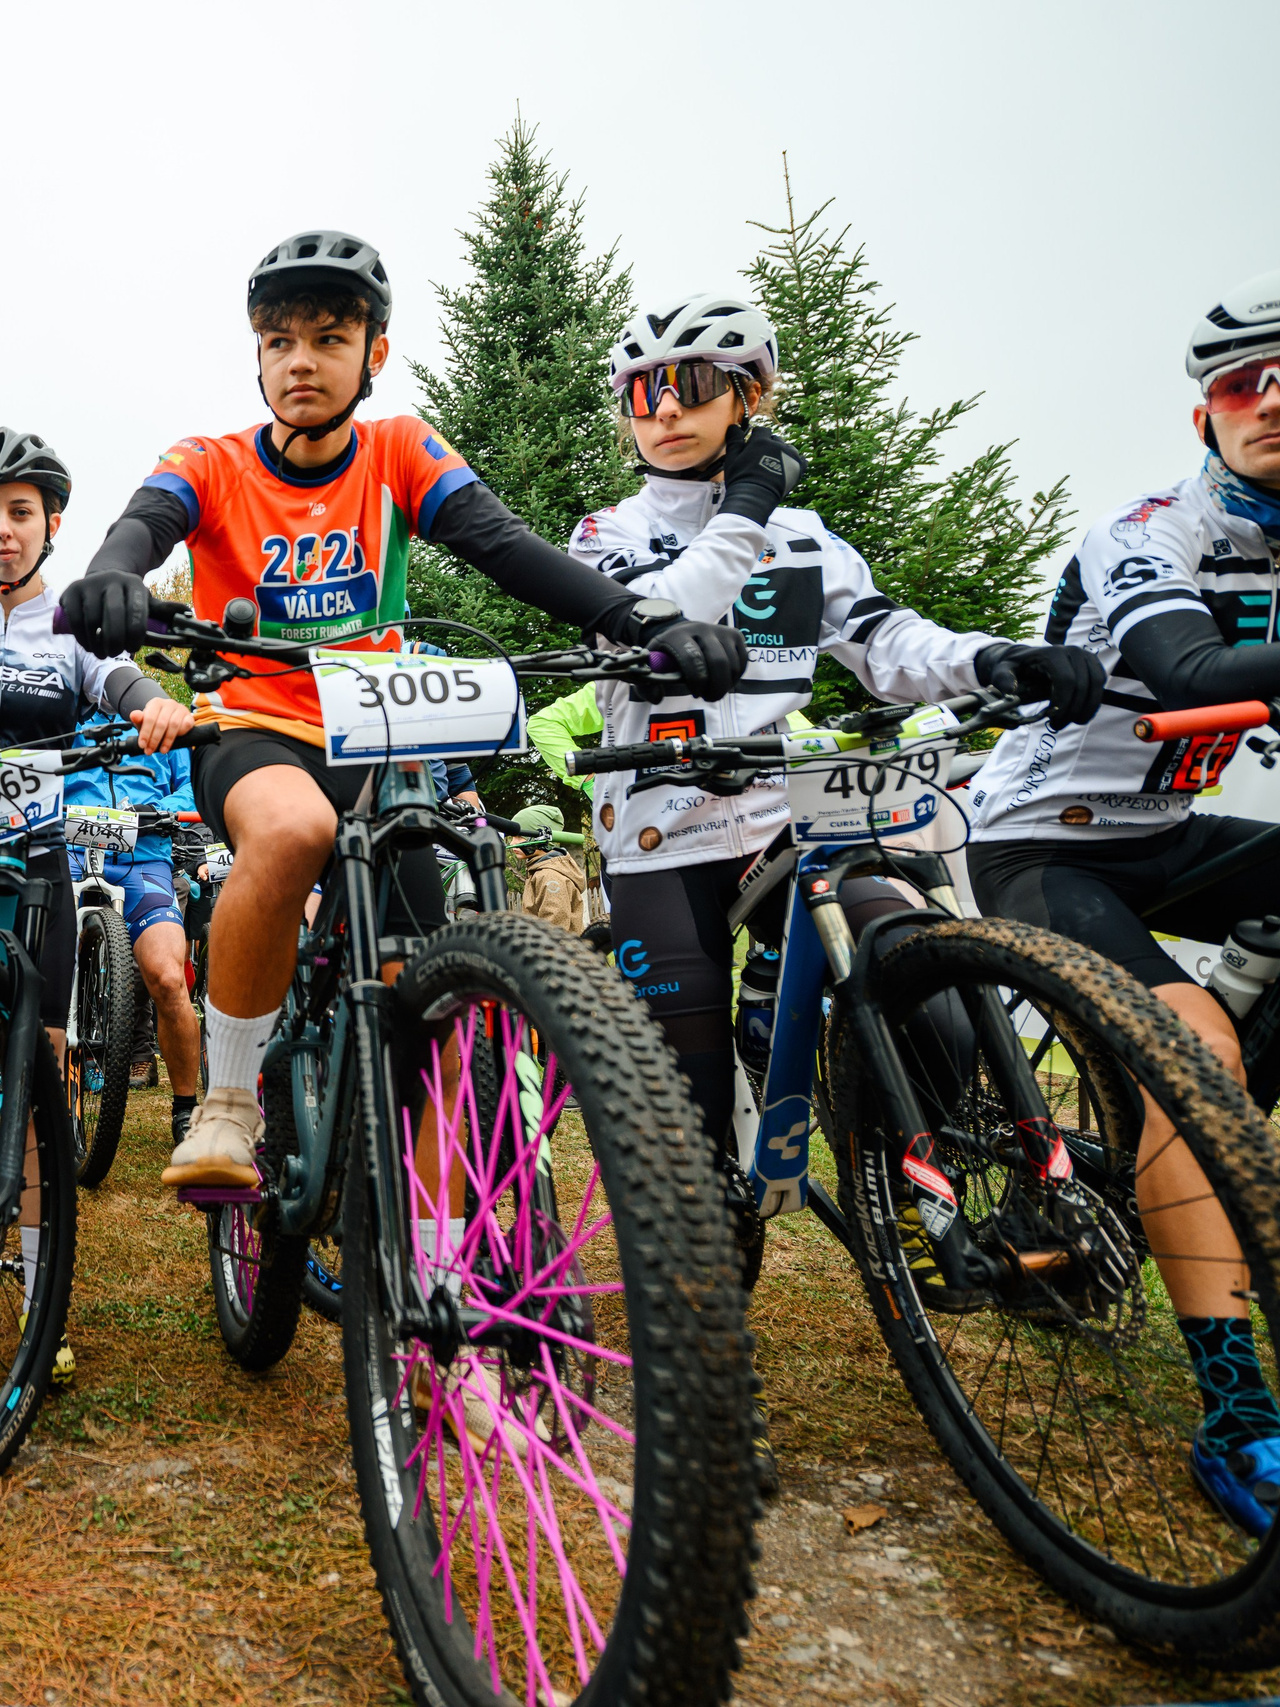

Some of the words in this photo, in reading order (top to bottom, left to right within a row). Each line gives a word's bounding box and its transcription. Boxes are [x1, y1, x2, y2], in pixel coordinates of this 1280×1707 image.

[283, 588, 356, 619] VÂLCEA
[281, 626, 318, 639] FOREST
[747, 648, 818, 662] CADEMY
[0, 683, 39, 695] TEAM
[355, 669, 481, 708] 3005
[883, 708, 910, 716] GARMIN
[824, 747, 940, 798] 4079
[1157, 763, 1179, 792] ACING
[26, 807, 40, 820] 21
[916, 801, 934, 816] 21
[829, 820, 862, 829] CURSA
